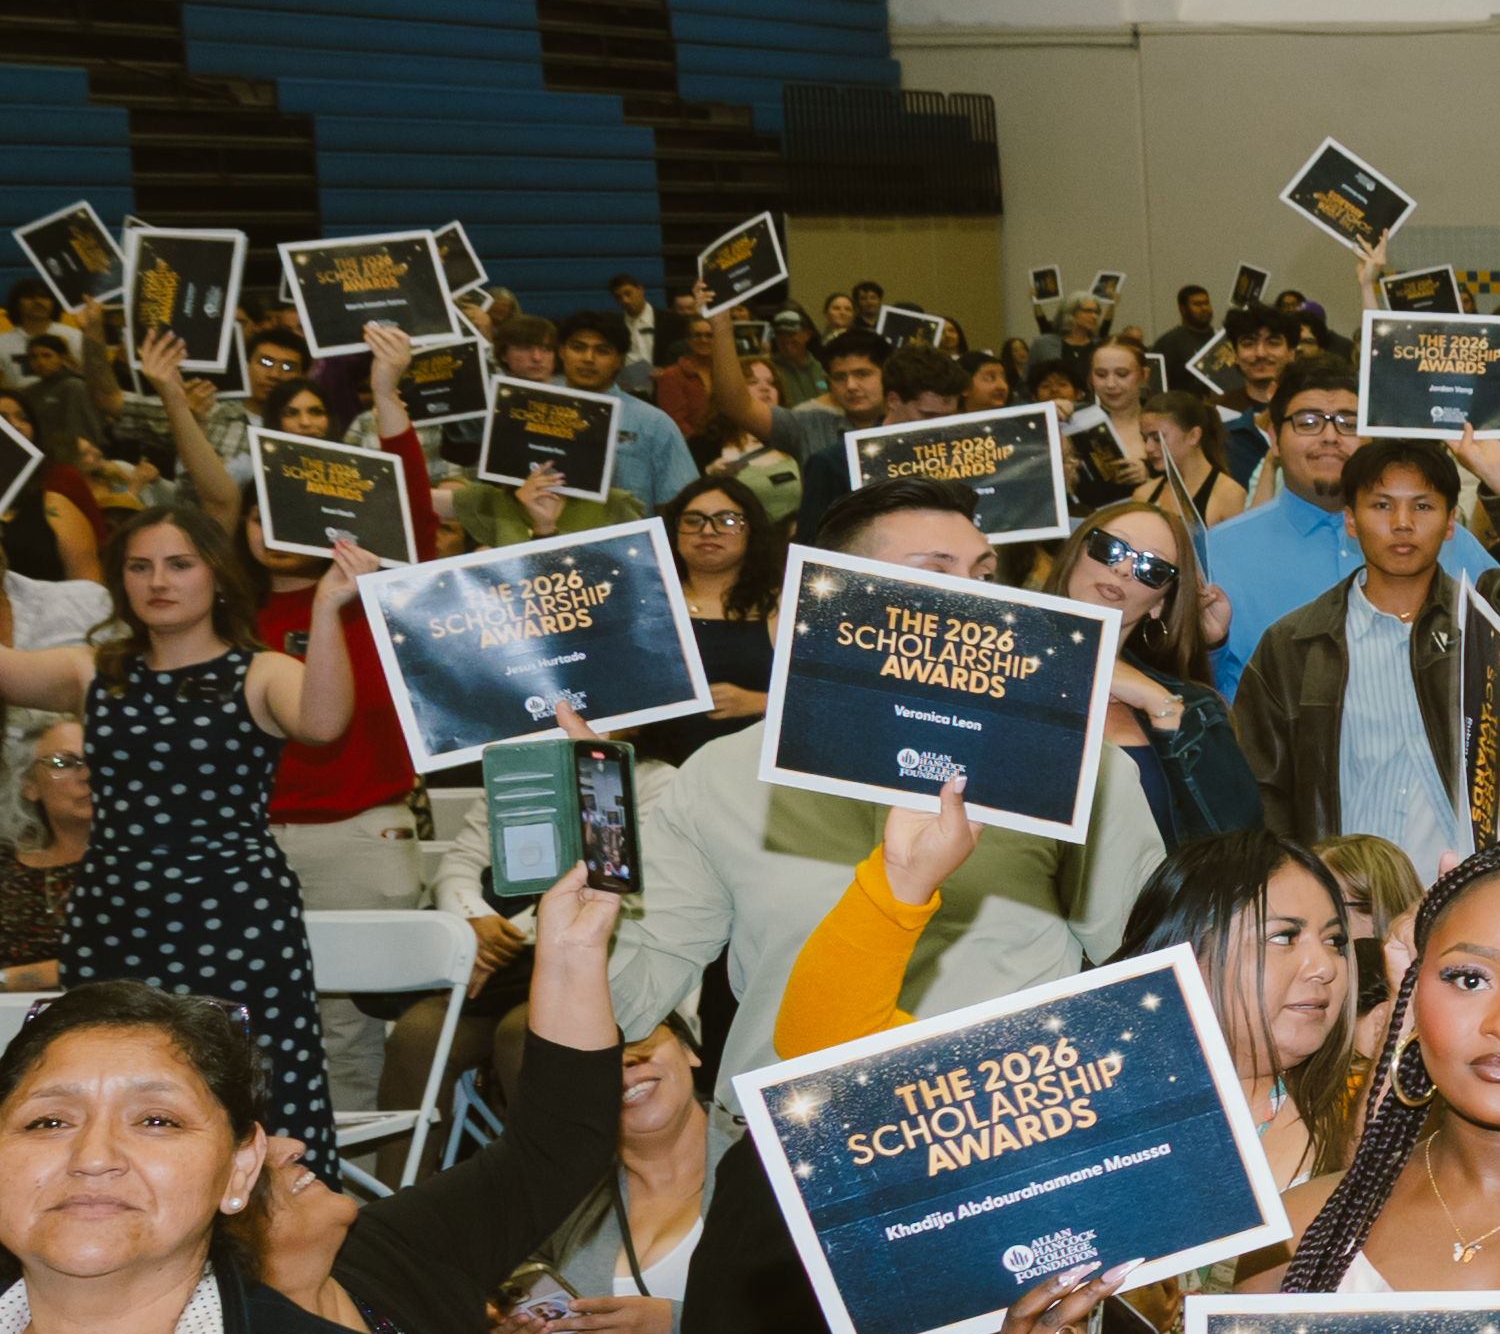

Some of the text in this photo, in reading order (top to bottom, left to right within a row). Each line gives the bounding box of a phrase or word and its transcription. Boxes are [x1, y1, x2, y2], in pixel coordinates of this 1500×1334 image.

[1418, 334, 1489, 349] THE 2026
[1418, 360, 1486, 374] AWARDS
[888, 444, 1014, 478] SCHOLARSHIP
[913, 436, 996, 460] THE 2026
[465, 570, 583, 609] THE 2026
[429, 584, 611, 639] SCHOLARSHIP
[480, 609, 593, 649] AWARDS
[886, 606, 1015, 652] THE 2026
[538, 651, 586, 668] Hurtado
[837, 622, 1040, 679] SCHOLARSHIP
[880, 655, 1006, 698] AWARDS
[894, 704, 982, 731] Veronica Leon
[895, 1037, 1079, 1116] THE 2026
[847, 1054, 1122, 1164] SCHOLARSHIP
[927, 1098, 1097, 1177] AWARDS
[885, 1143, 1171, 1241] Khadija Abdourahamane Moussa
[1031, 1227, 1072, 1248] ALLAN
[1033, 1229, 1097, 1257] HANCOCK
[1035, 1241, 1092, 1266] COLLEGE
[1015, 1247, 1098, 1284] FOUNDATION
